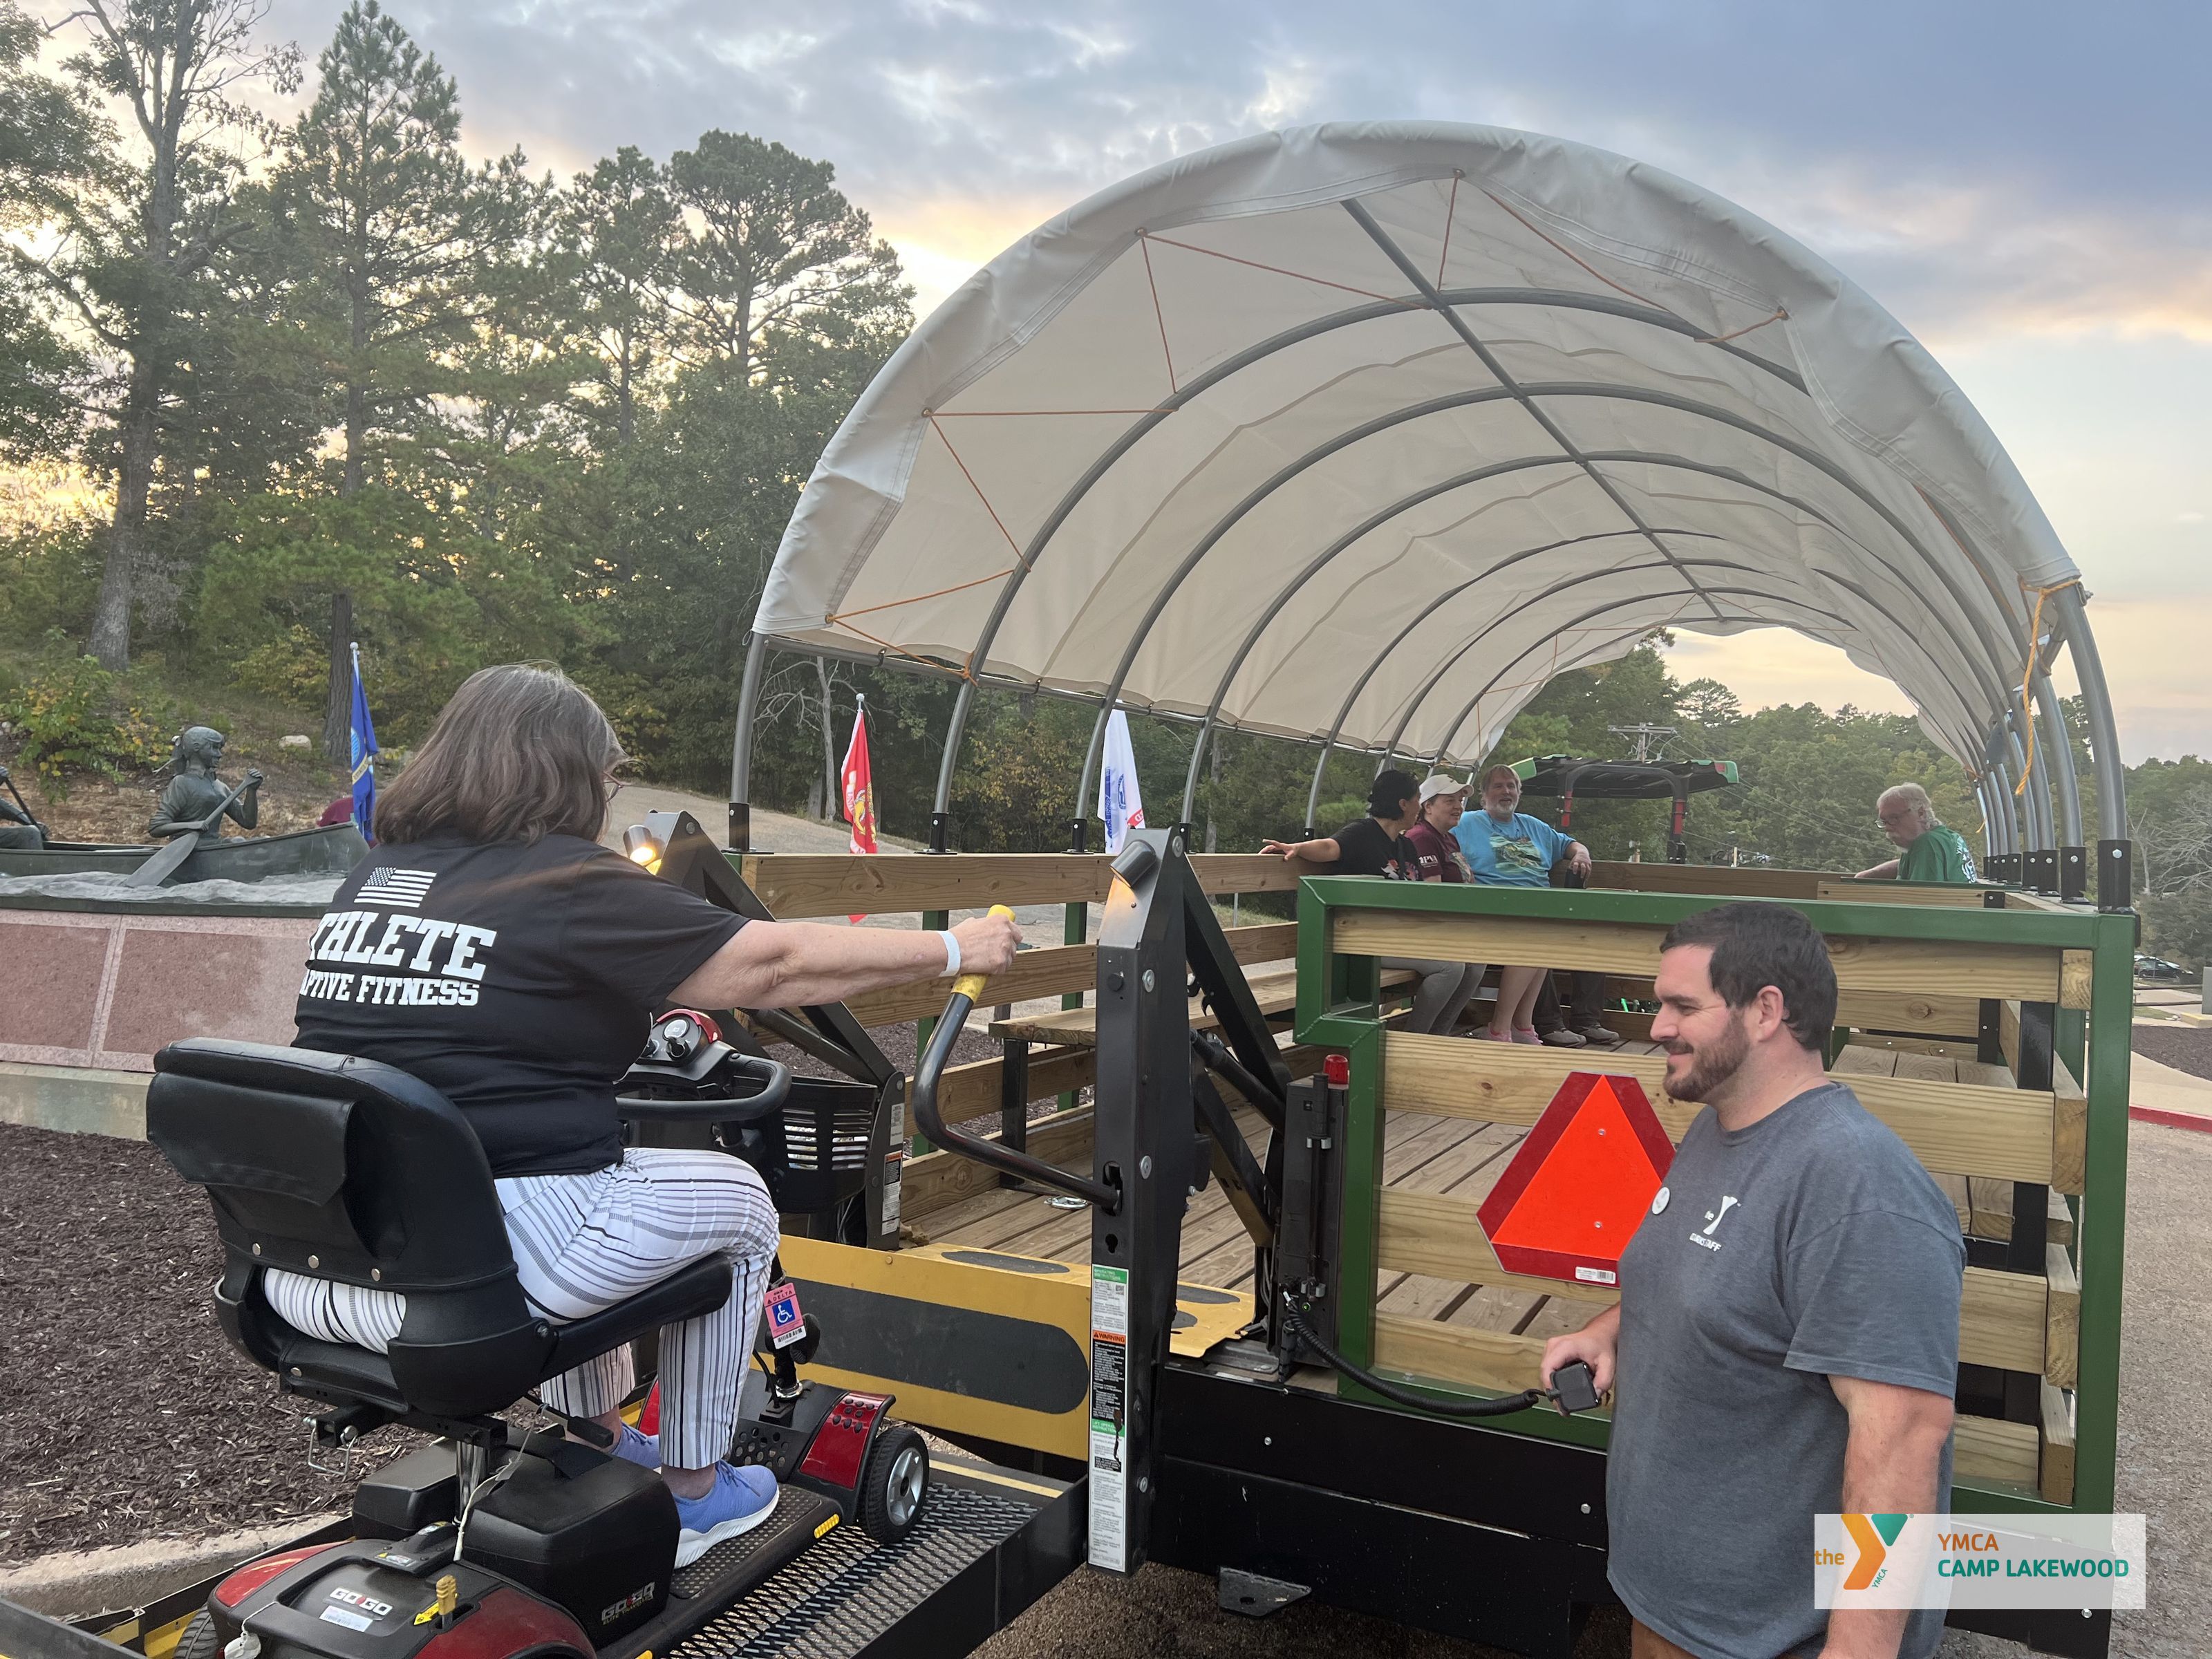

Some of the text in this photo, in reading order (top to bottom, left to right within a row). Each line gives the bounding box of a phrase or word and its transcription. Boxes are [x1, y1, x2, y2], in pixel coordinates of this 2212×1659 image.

[355, 975, 480, 1006] FITNESS
[773, 1290, 793, 1301] DELTA
[1098, 1332, 1125, 1342] WARNING
